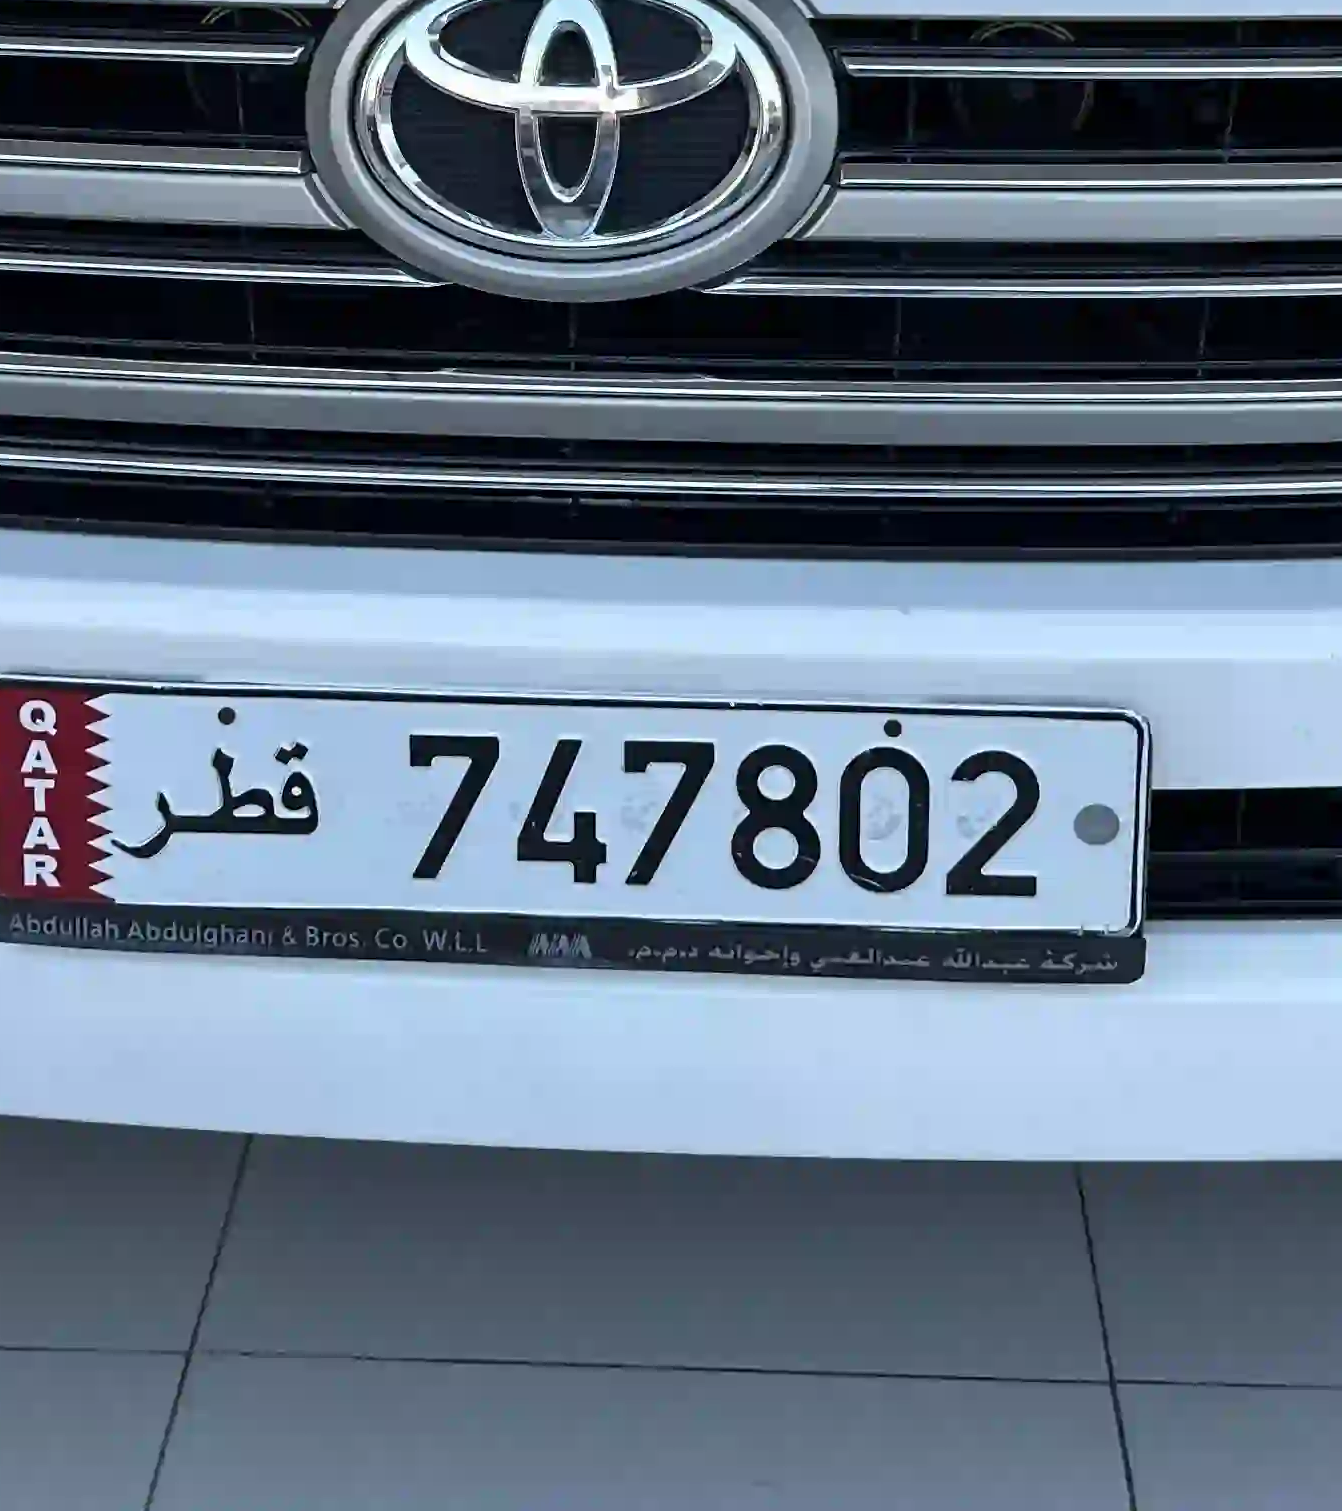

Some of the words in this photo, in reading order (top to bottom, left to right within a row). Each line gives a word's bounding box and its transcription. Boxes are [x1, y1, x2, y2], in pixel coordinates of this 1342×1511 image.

[18, 699, 61, 888] QATAR
[111, 740, 319, 859] قطر
[409, 734, 1041, 897] 747802
[9, 912, 119, 940] Abdullah
[128, 919, 273, 947] Abdulghani
[282, 925, 297, 945] &
[1039, 949, 1118, 975] شركة
